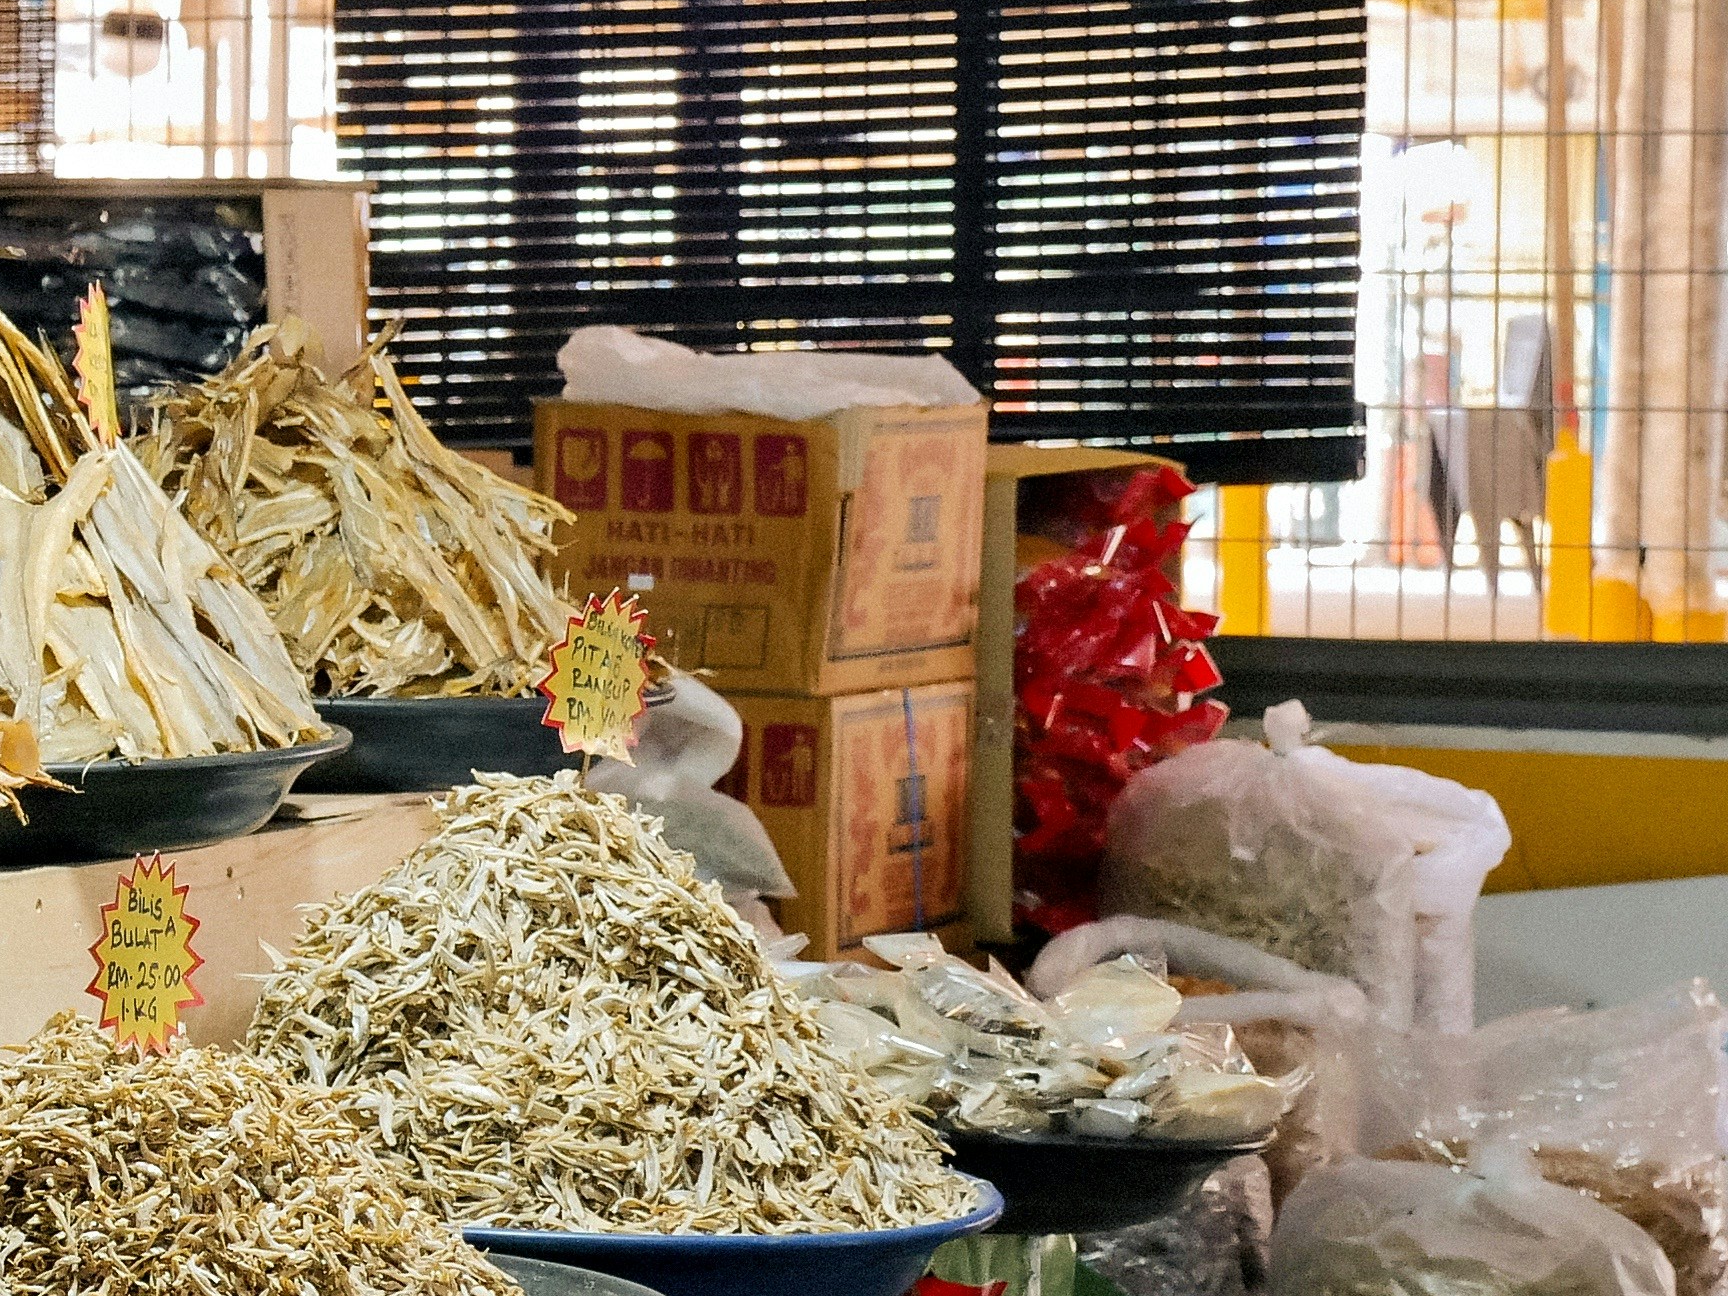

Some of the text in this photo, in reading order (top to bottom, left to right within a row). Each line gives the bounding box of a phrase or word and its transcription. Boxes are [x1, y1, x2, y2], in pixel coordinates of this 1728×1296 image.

[604, 519, 757, 546] HATI-HATI
[572, 668, 631, 700] RANGUP
[110, 915, 176, 951] BULAT A
[136, 961, 181, 990] 25.00
